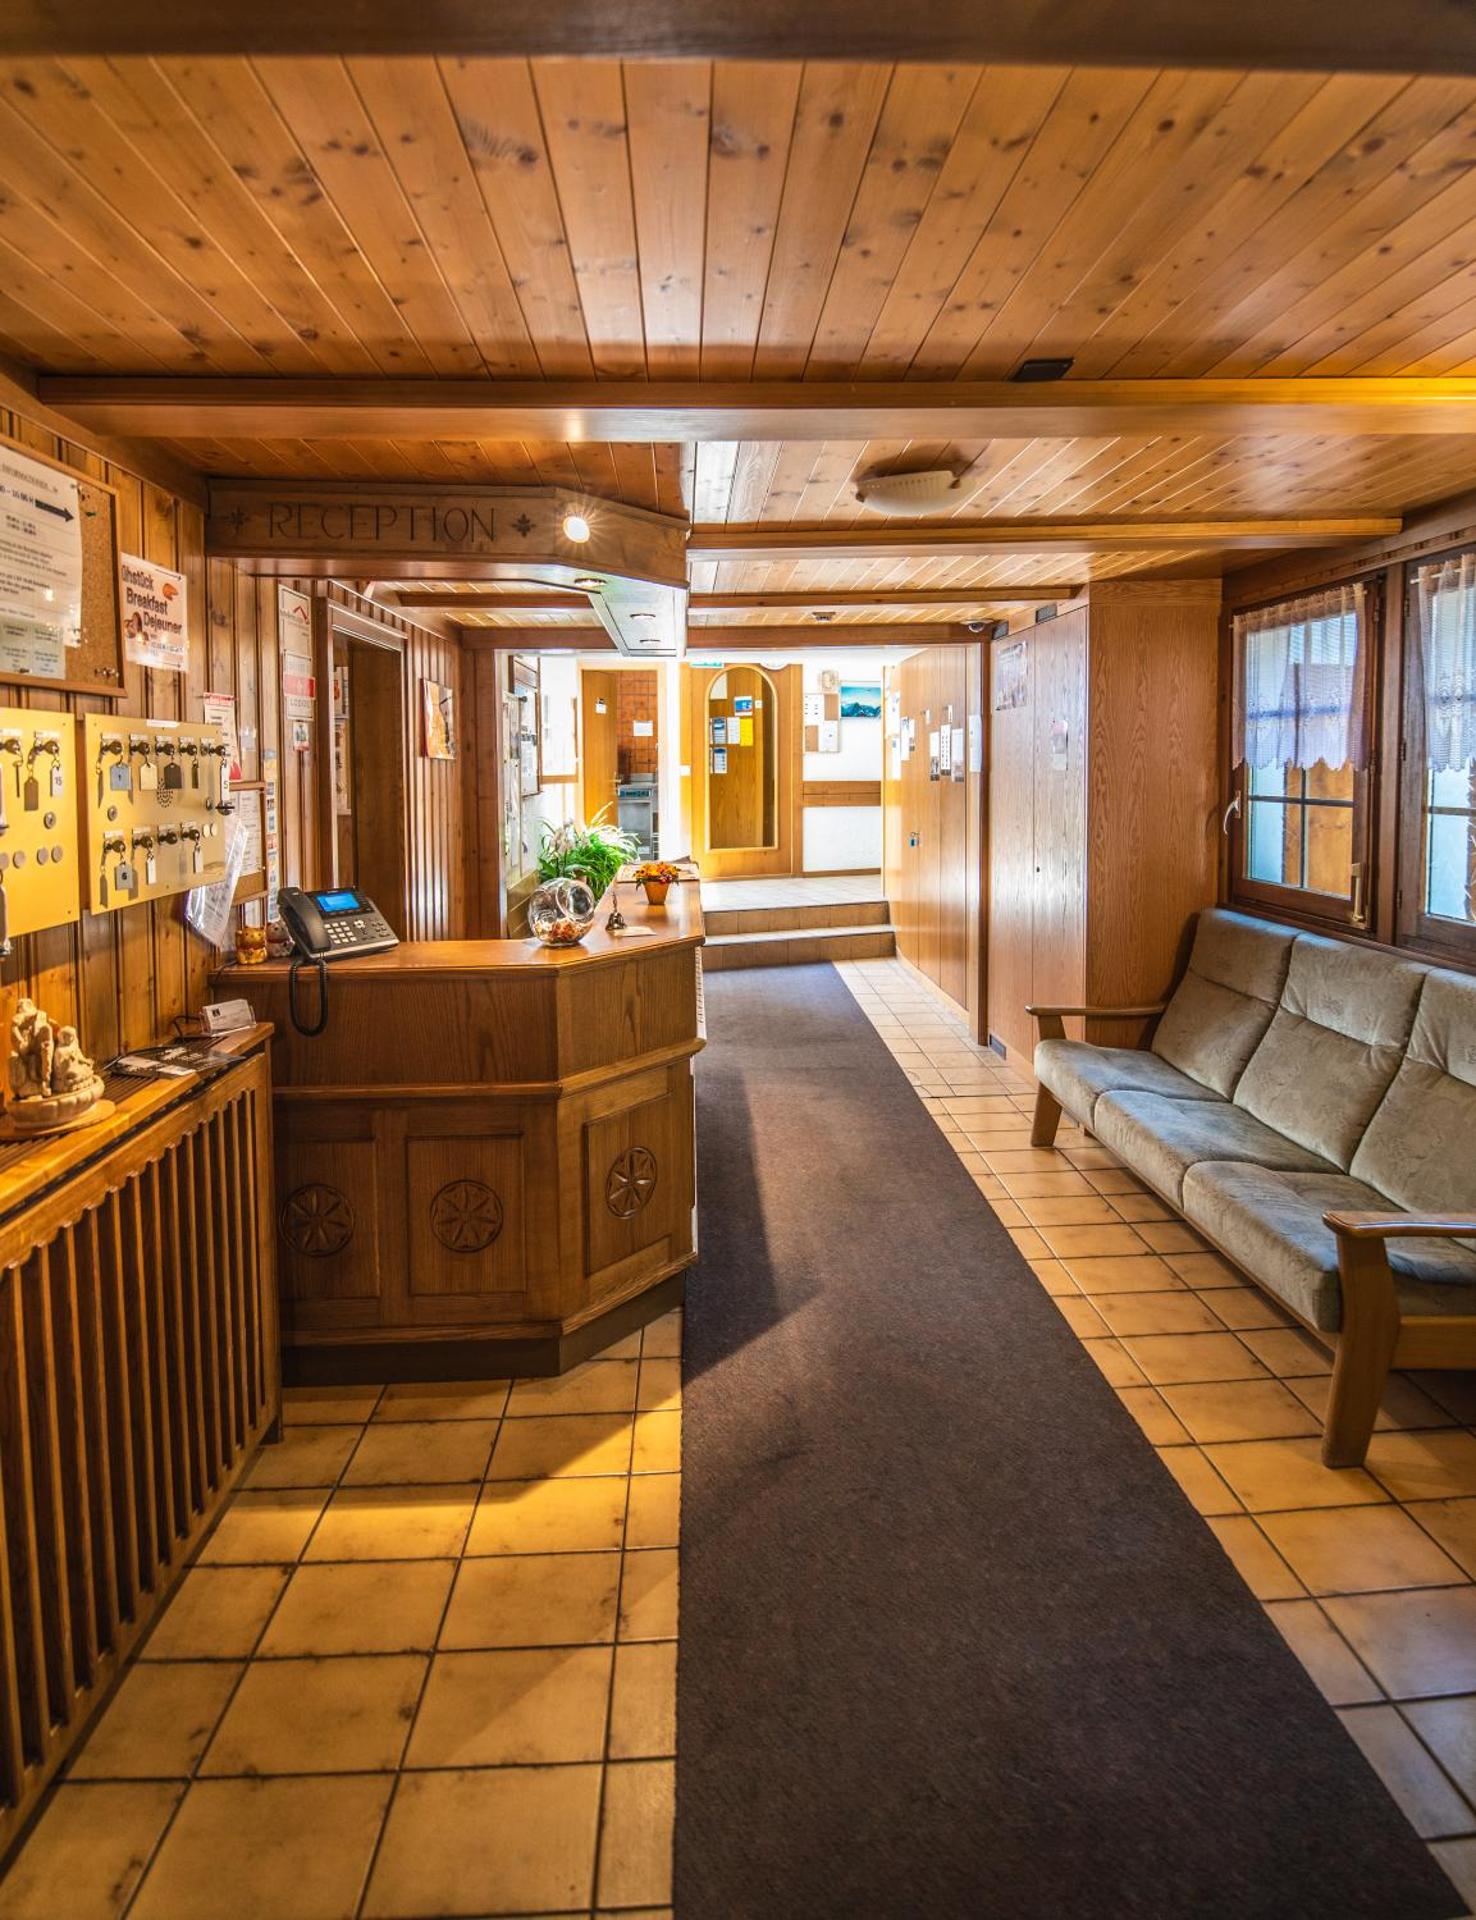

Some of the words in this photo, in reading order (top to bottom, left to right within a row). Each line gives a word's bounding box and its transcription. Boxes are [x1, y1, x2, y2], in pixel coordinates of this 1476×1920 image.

[265, 503, 496, 543] RECEPTION
[121, 565, 154, 592] ühstück
[126, 587, 168, 616] Breakfast
[54, 776, 63, 786] 15
[223, 781, 229, 789] 5
